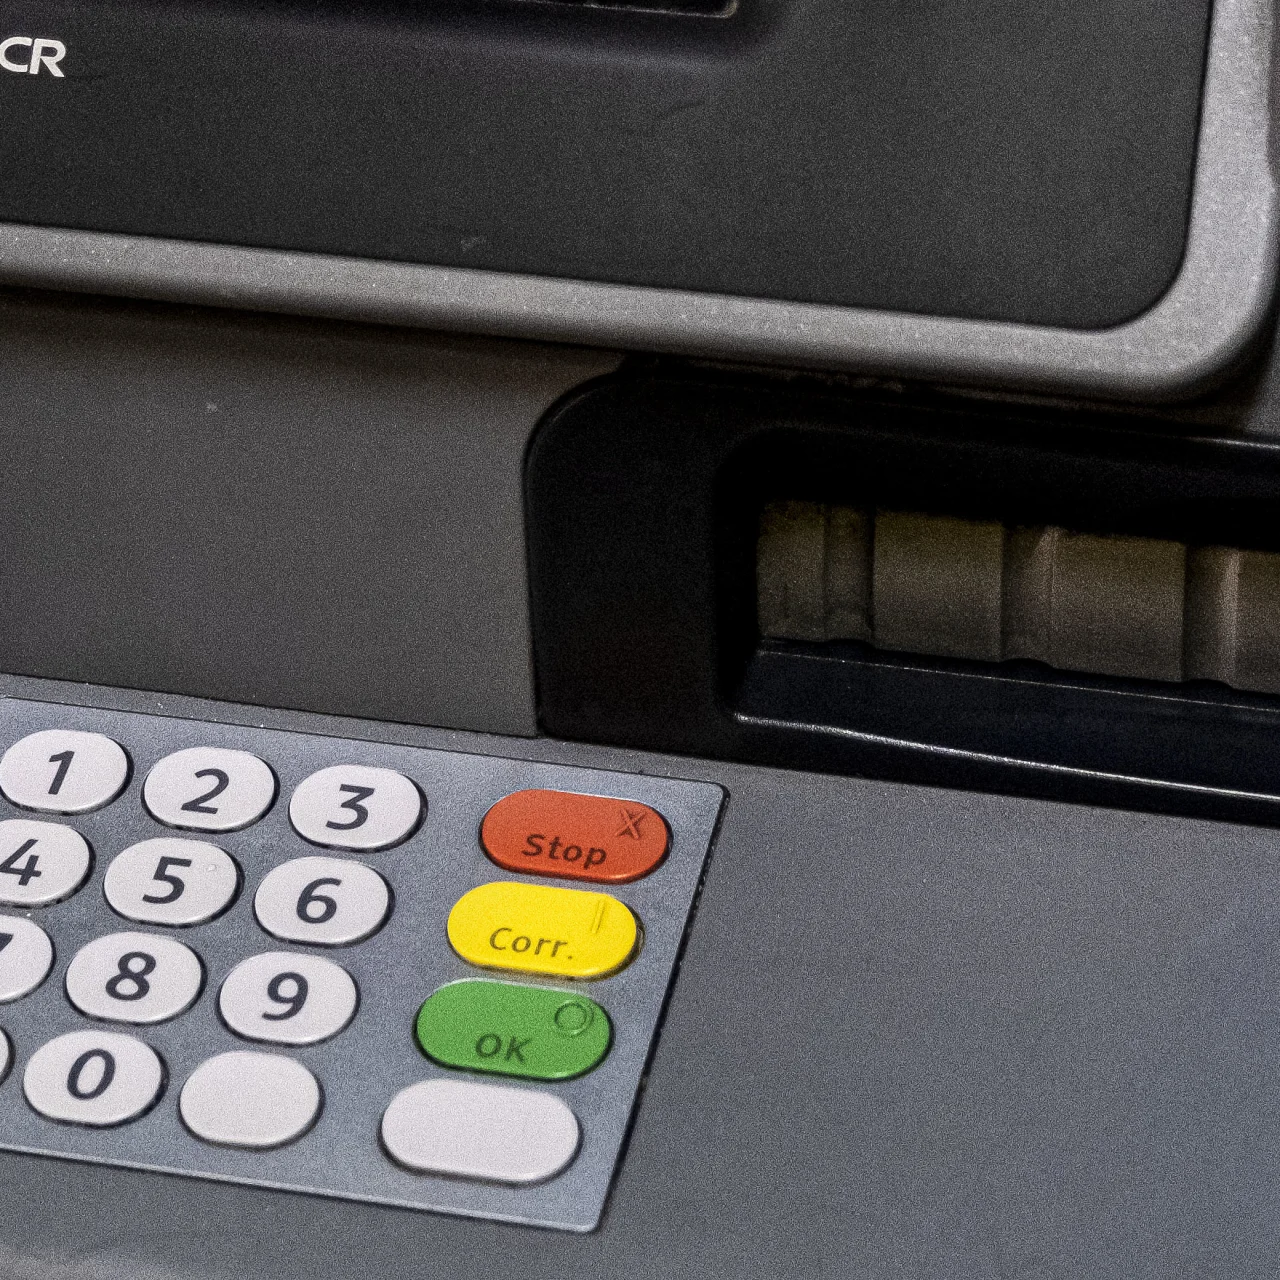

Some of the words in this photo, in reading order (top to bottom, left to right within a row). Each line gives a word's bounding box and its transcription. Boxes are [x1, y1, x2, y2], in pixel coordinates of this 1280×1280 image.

[47, 750, 75, 796] 1
[180, 767, 230, 815] 2
[325, 783, 375, 831] 3
[519, 830, 608, 870] Stop
[142, 855, 193, 905] 5
[295, 877, 342, 925] 6
[488, 924, 576, 964] Corr.
[104, 951, 157, 1002] 8
[261, 971, 309, 1022] 9
[475, 1031, 533, 1065] OK
[66, 1048, 117, 1101] 0
